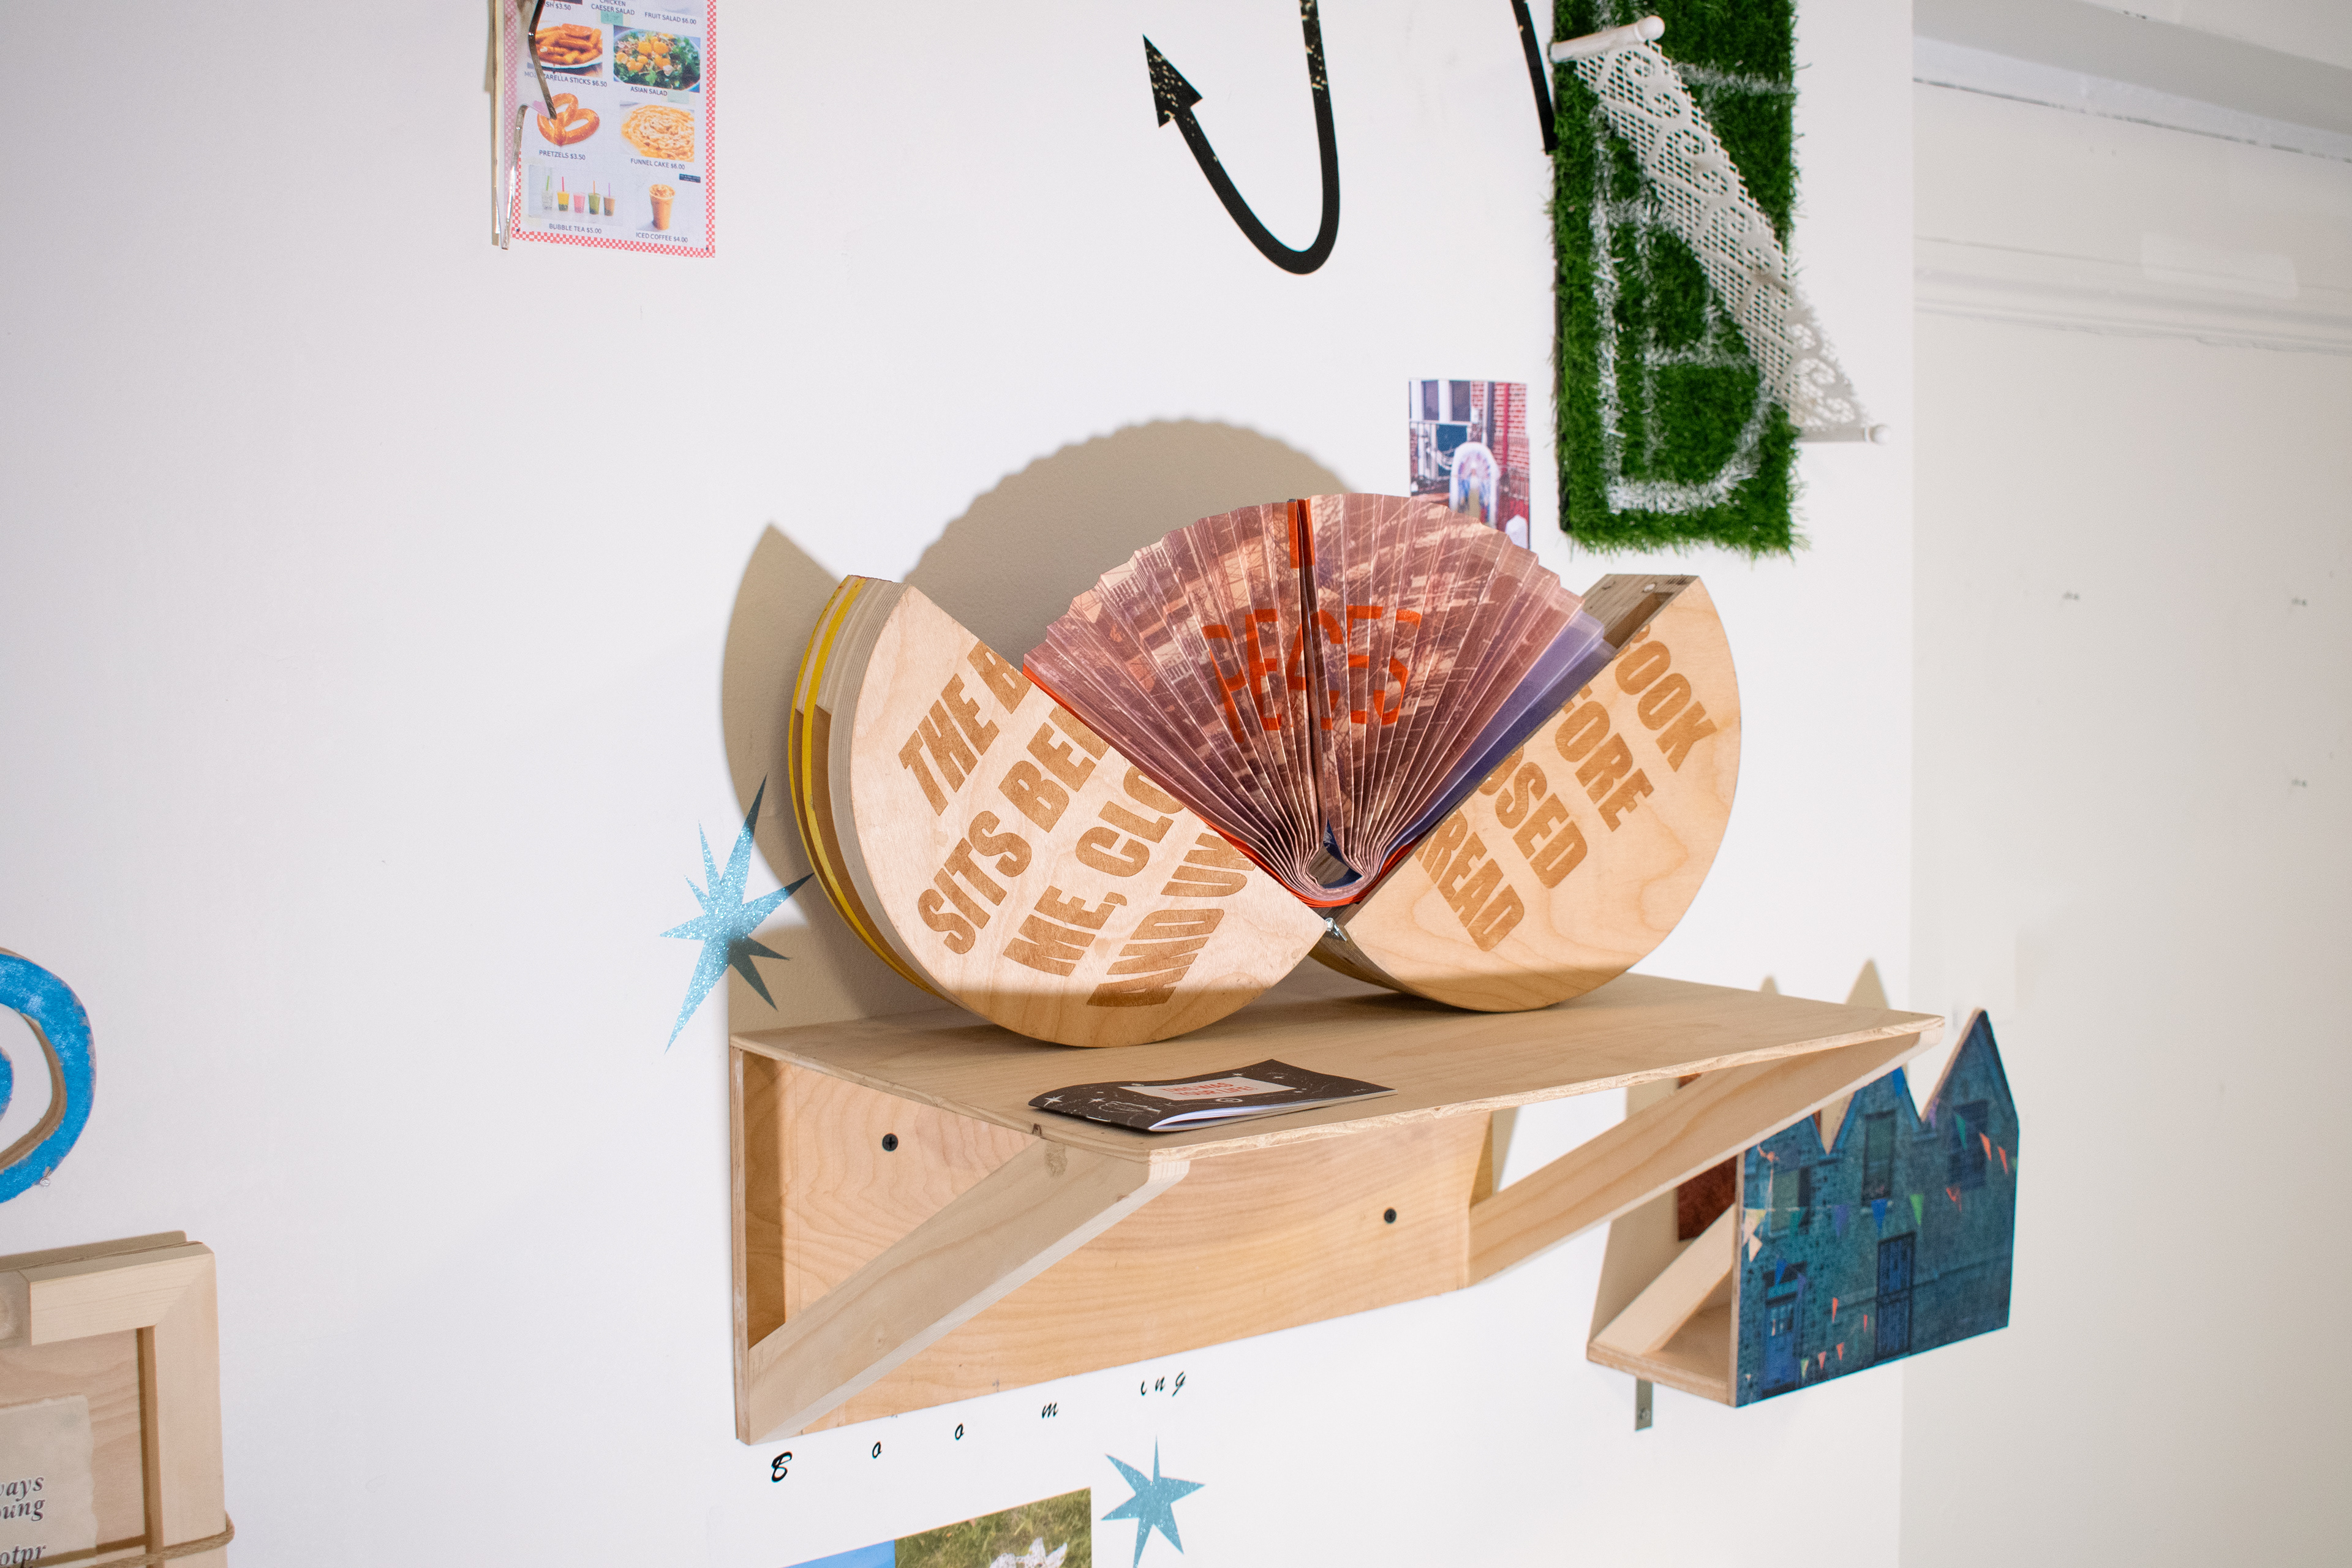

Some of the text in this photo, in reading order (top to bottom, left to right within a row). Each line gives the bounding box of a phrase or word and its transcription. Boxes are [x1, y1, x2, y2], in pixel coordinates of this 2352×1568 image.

[539, 150, 569, 159] PRETZELS
[898, 673, 1000, 816] THE
[1555, 684, 1654, 832] ORE
[917, 810, 1033, 955] SITS
[1003, 885, 1128, 978] ME,
[1414, 809, 1525, 952] READ
[1086, 908, 1224, 1008] AND
